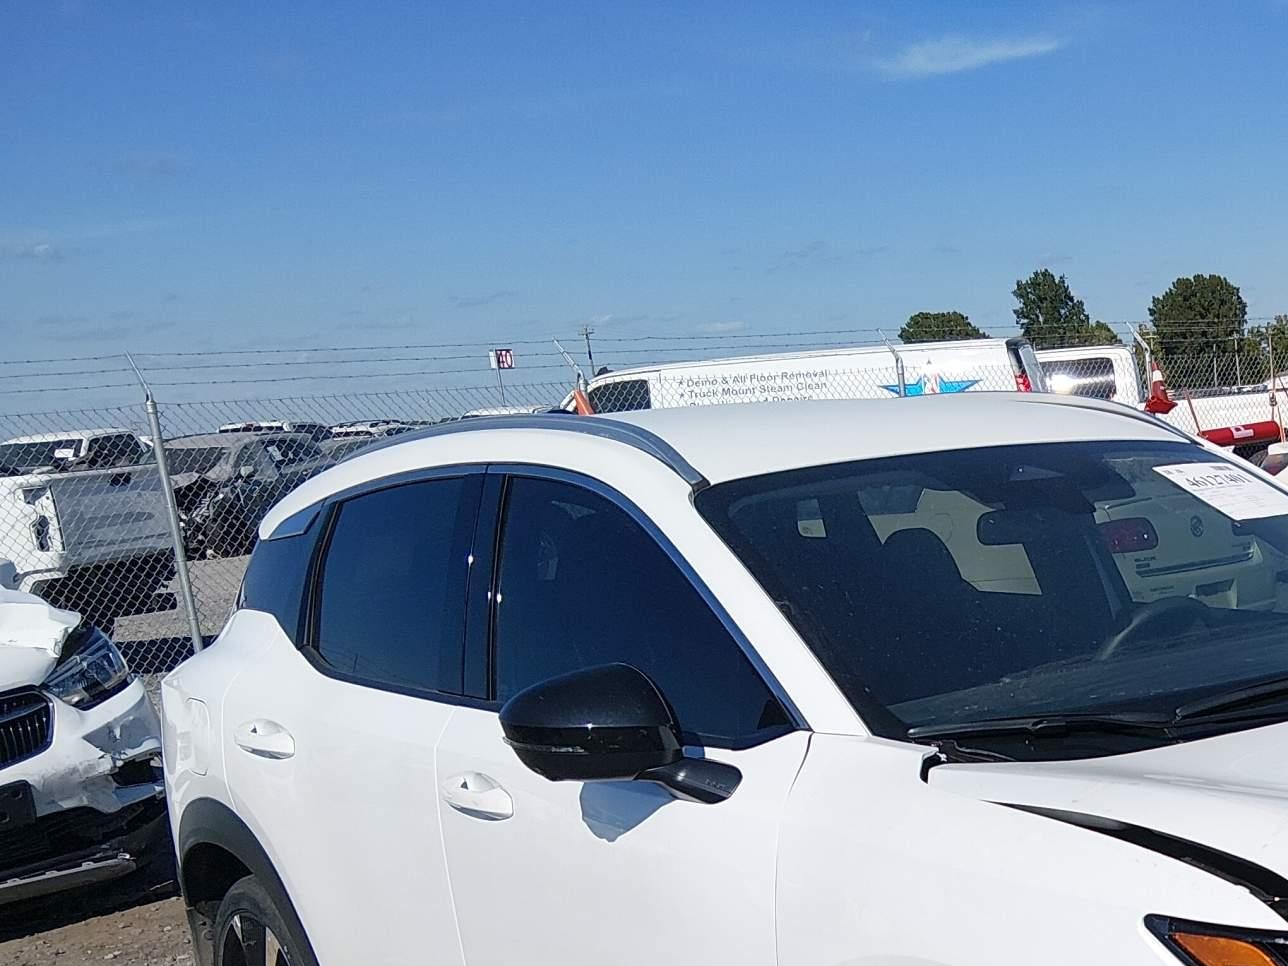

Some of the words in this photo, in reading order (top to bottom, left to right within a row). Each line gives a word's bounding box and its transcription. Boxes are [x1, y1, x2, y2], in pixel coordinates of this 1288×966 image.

[687, 379, 718, 387] Demo
[732, 375, 746, 384] All
[750, 374, 778, 384] Floor
[781, 369, 828, 382] Removal
[688, 389, 719, 399] Truck
[722, 387, 756, 397] Mount
[759, 384, 793, 393] Steam
[796, 382, 828, 392] Clean
[1185, 473, 1252, 487] 46127401
